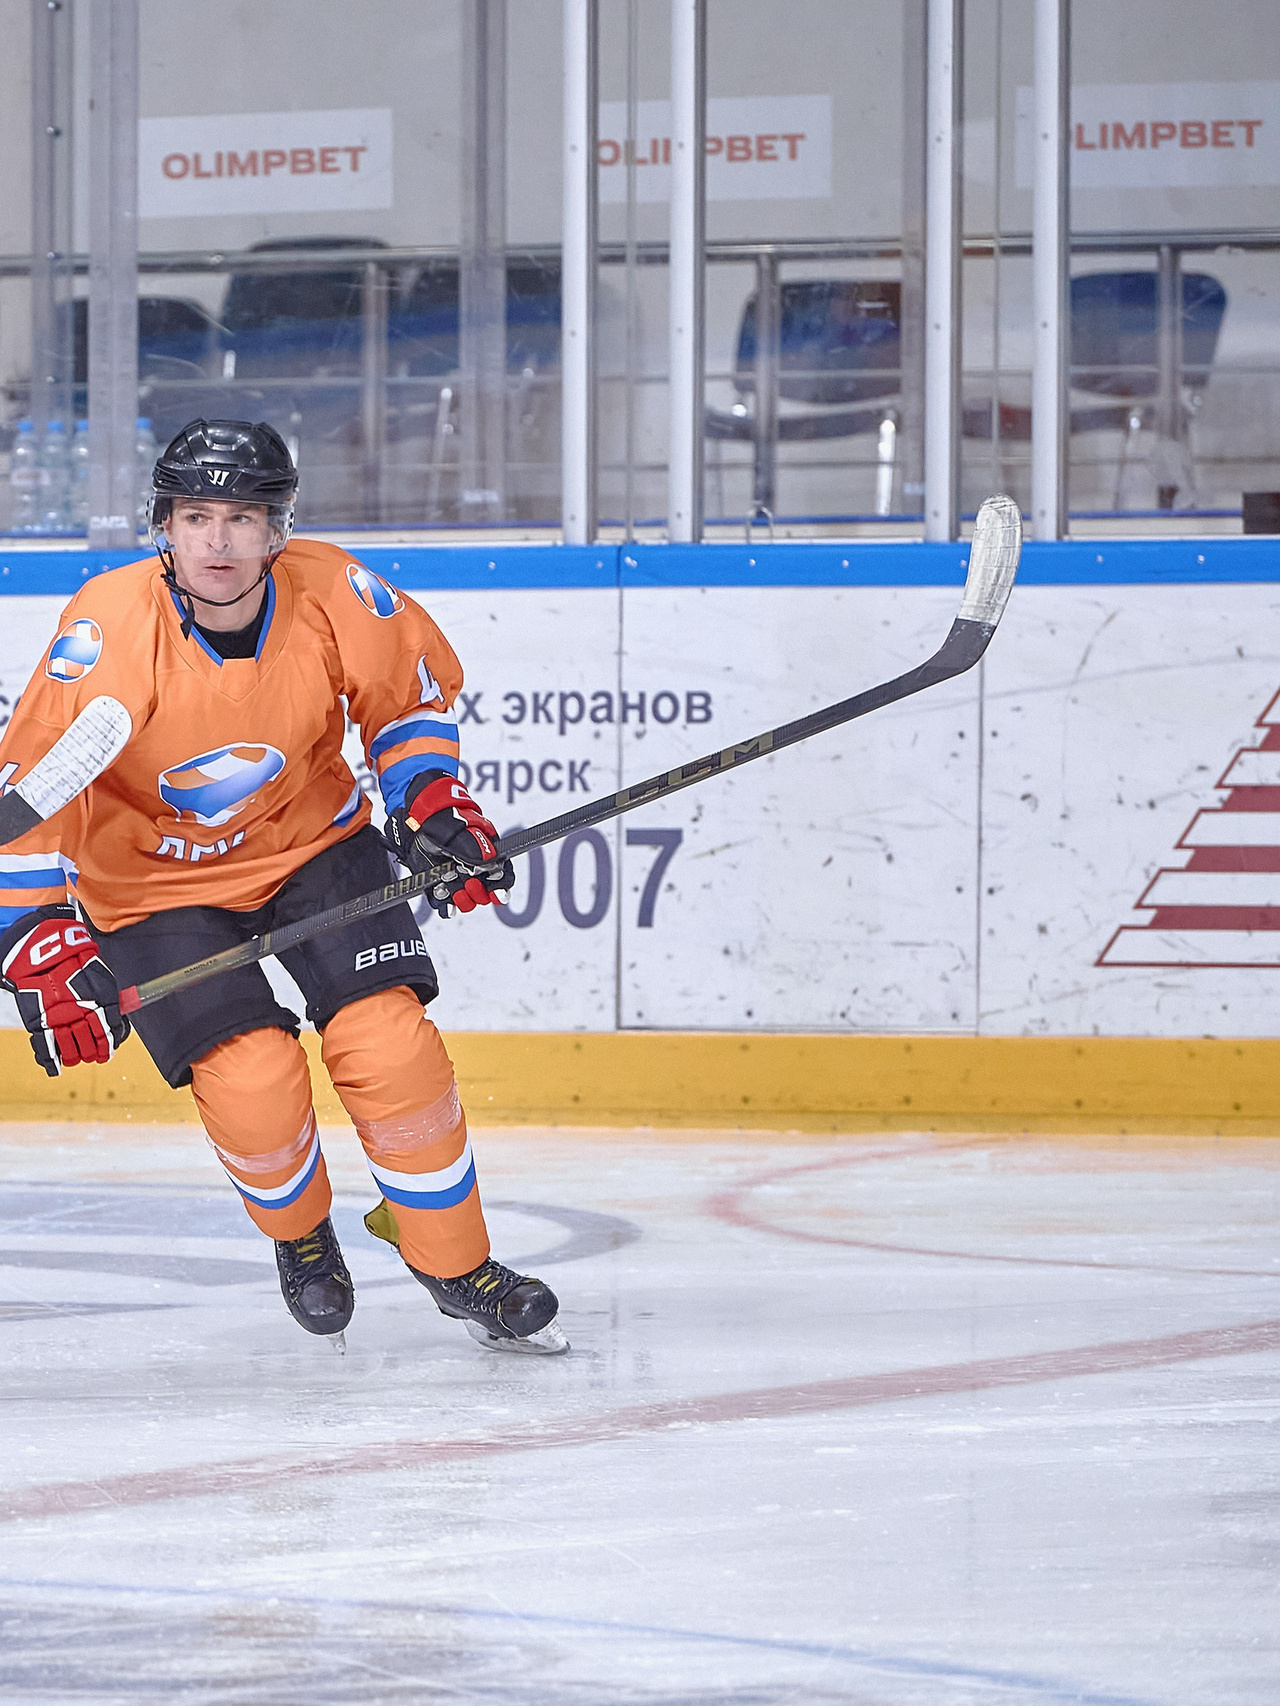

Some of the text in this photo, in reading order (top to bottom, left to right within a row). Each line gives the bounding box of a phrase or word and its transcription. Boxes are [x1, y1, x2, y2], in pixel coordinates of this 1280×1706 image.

[1073, 120, 1264, 151] LIMPBET
[161, 145, 367, 181] OLIMPBET
[501, 689, 714, 736] экранов
[391, 815, 401, 846] CCM
[475, 830, 491, 854] CCM
[383, 861, 453, 902] GHOST
[29, 925, 92, 966] CC
[354, 939, 431, 972] BAUE
